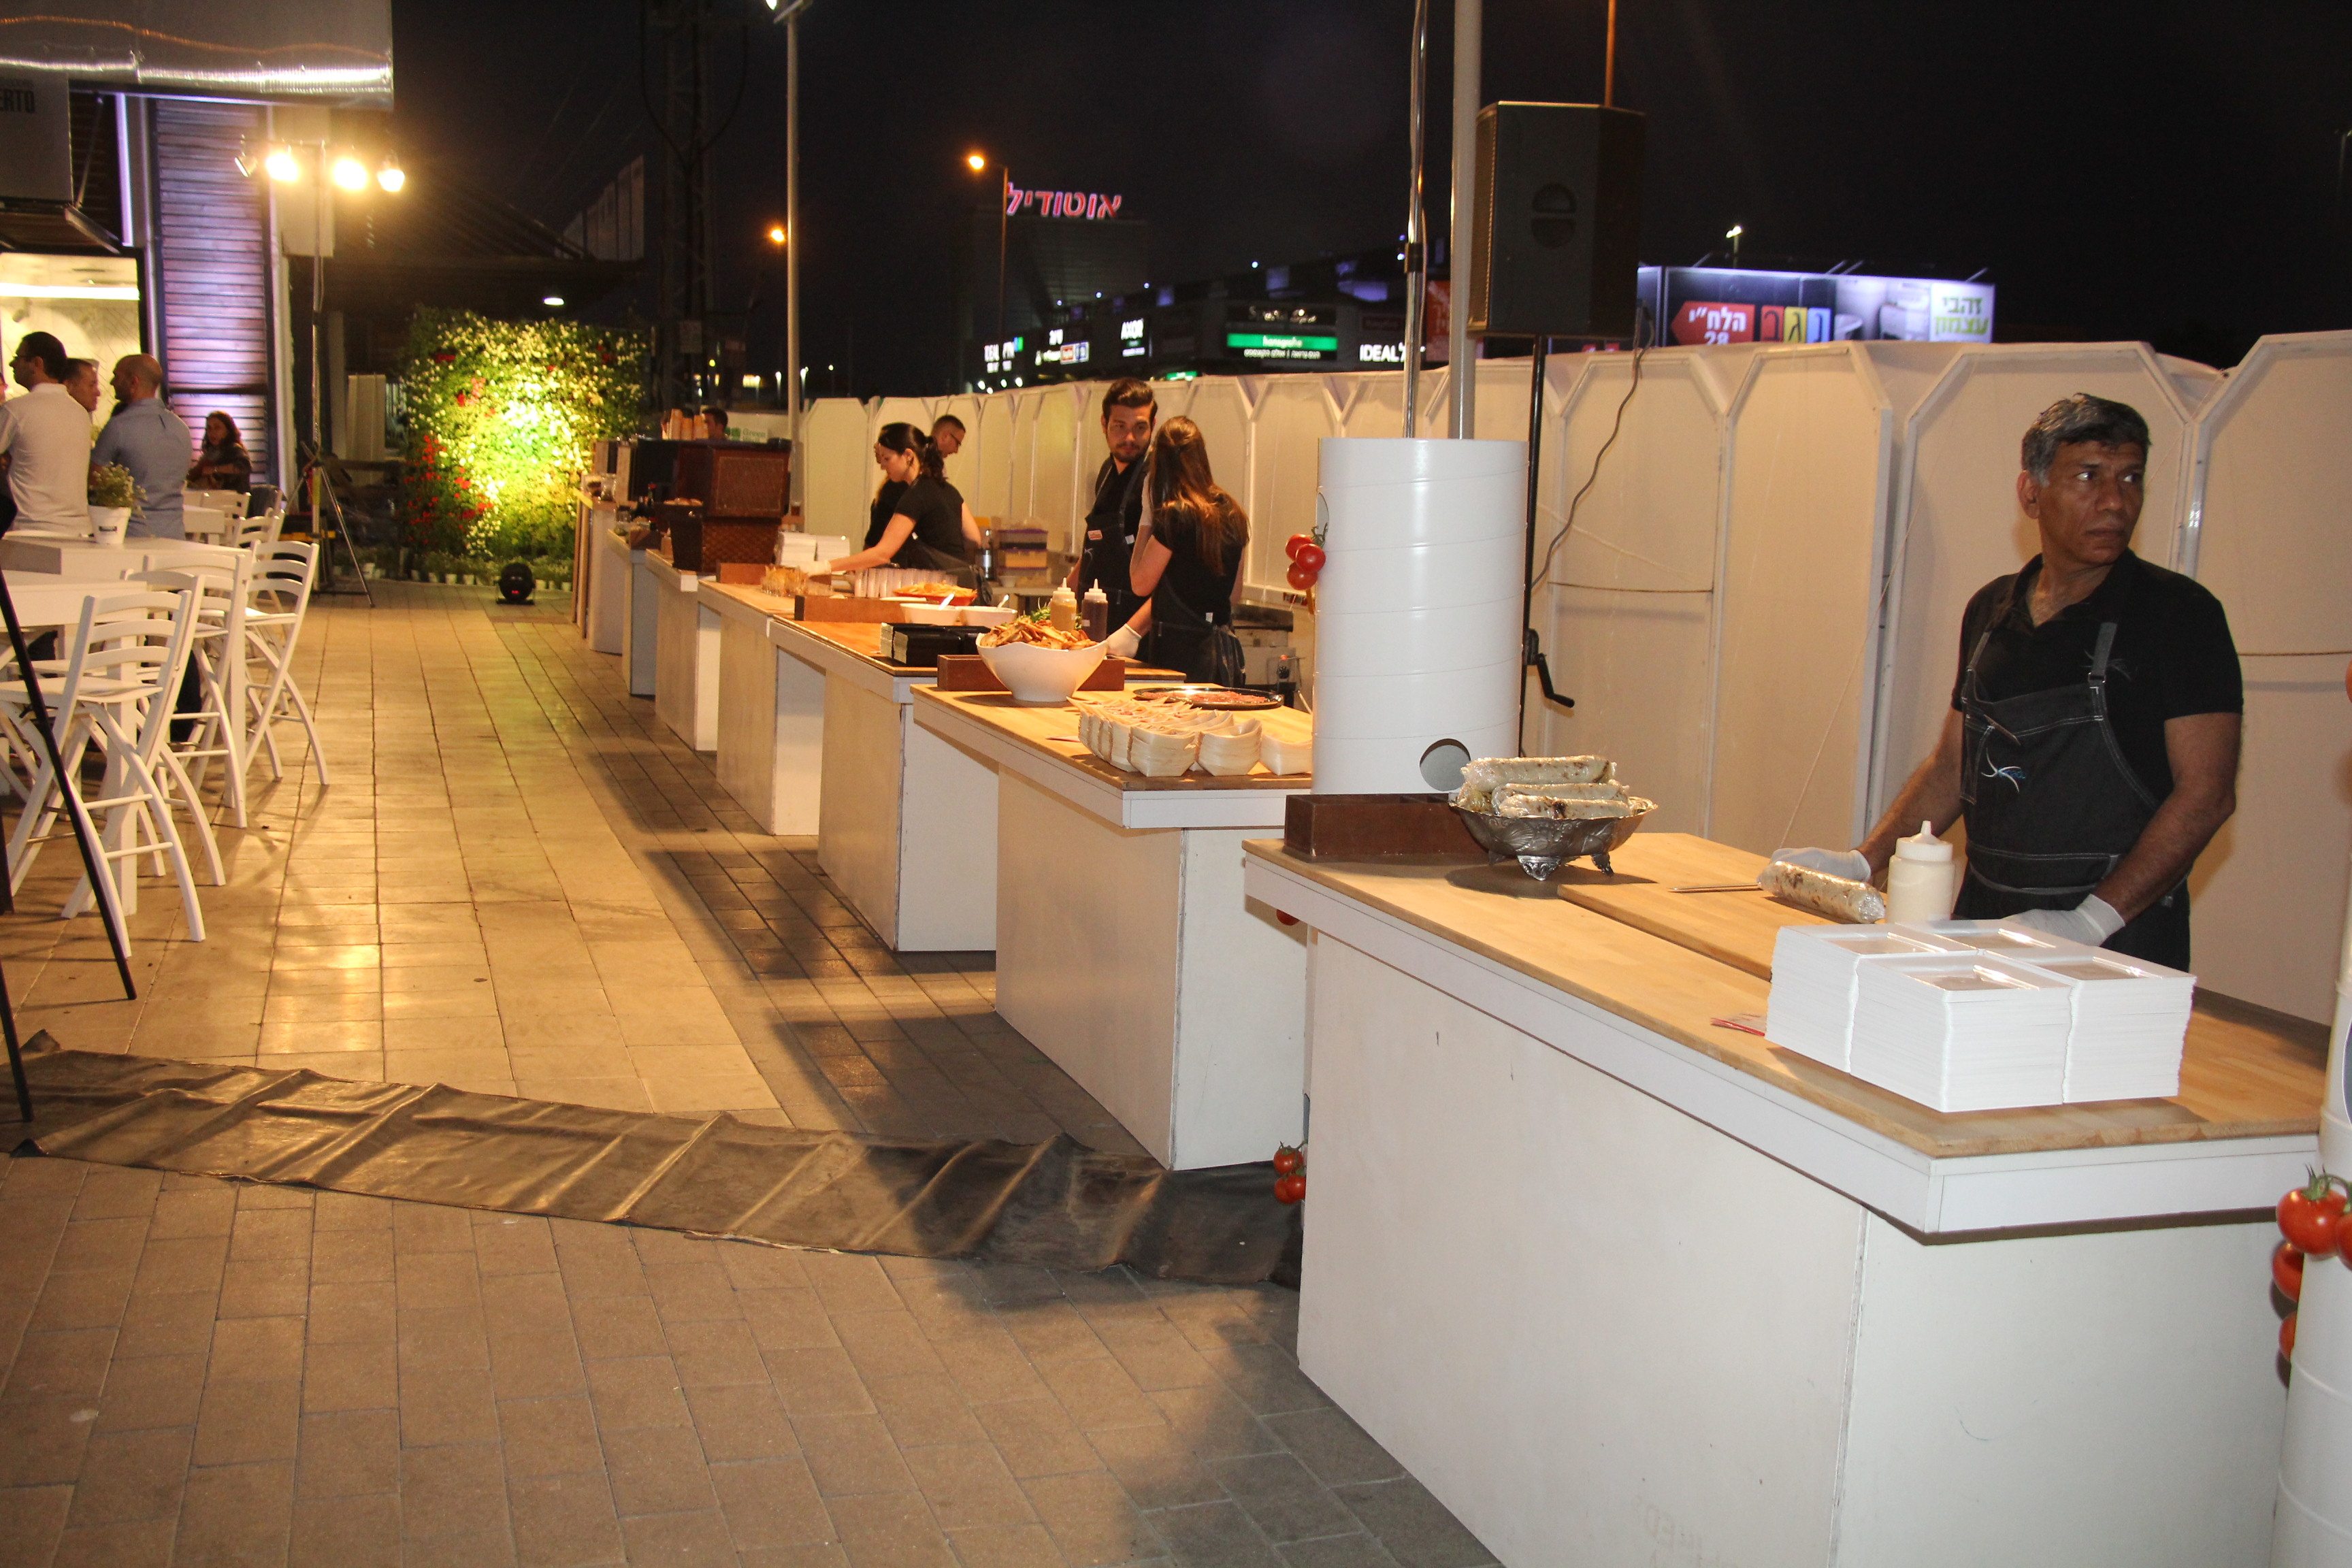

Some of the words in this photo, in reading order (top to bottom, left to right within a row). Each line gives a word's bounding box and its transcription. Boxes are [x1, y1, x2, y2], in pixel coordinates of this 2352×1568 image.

[1007, 181, 1122, 219] אוטודיל
[1942, 297, 1983, 314] זהבי
[1360, 344, 1400, 362] IDEAL
